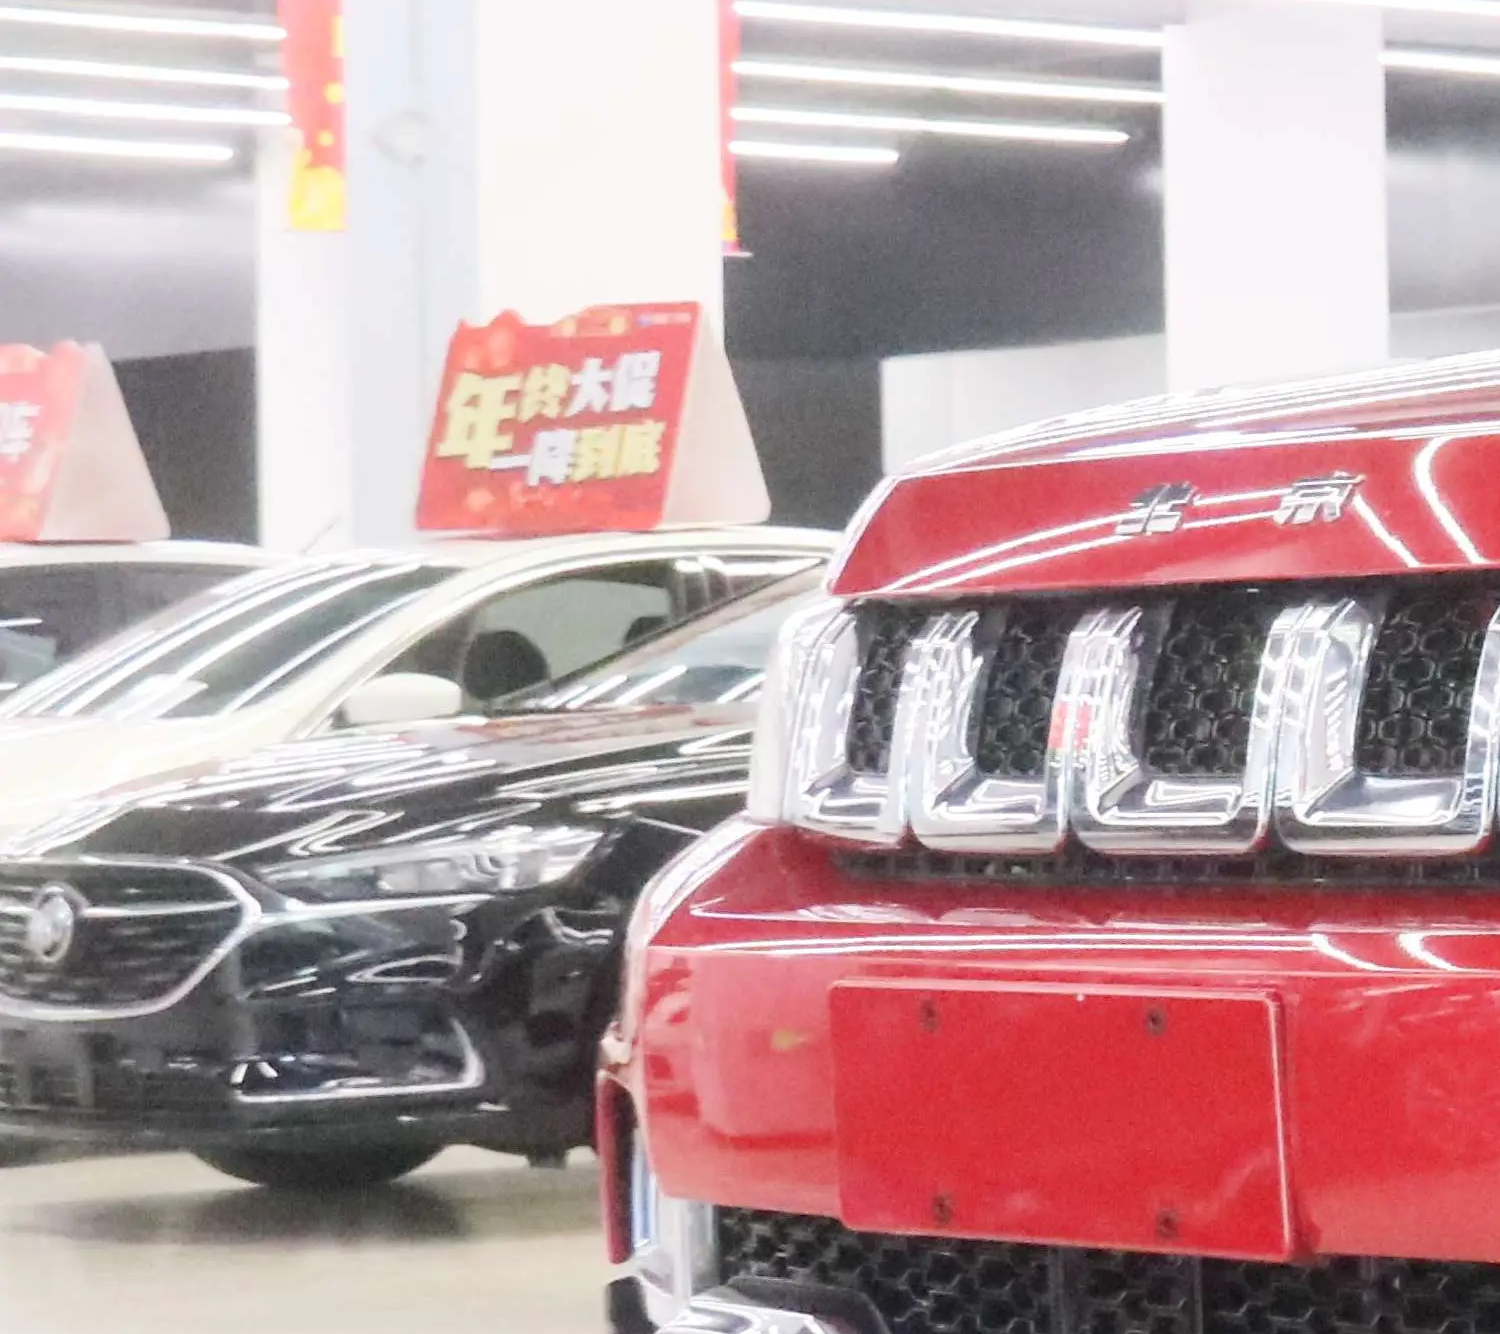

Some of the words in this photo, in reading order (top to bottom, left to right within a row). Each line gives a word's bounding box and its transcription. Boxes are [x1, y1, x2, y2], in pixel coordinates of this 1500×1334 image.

[436, 350, 661, 470] 年终大促
[489, 419, 666, 487] 一降到底
